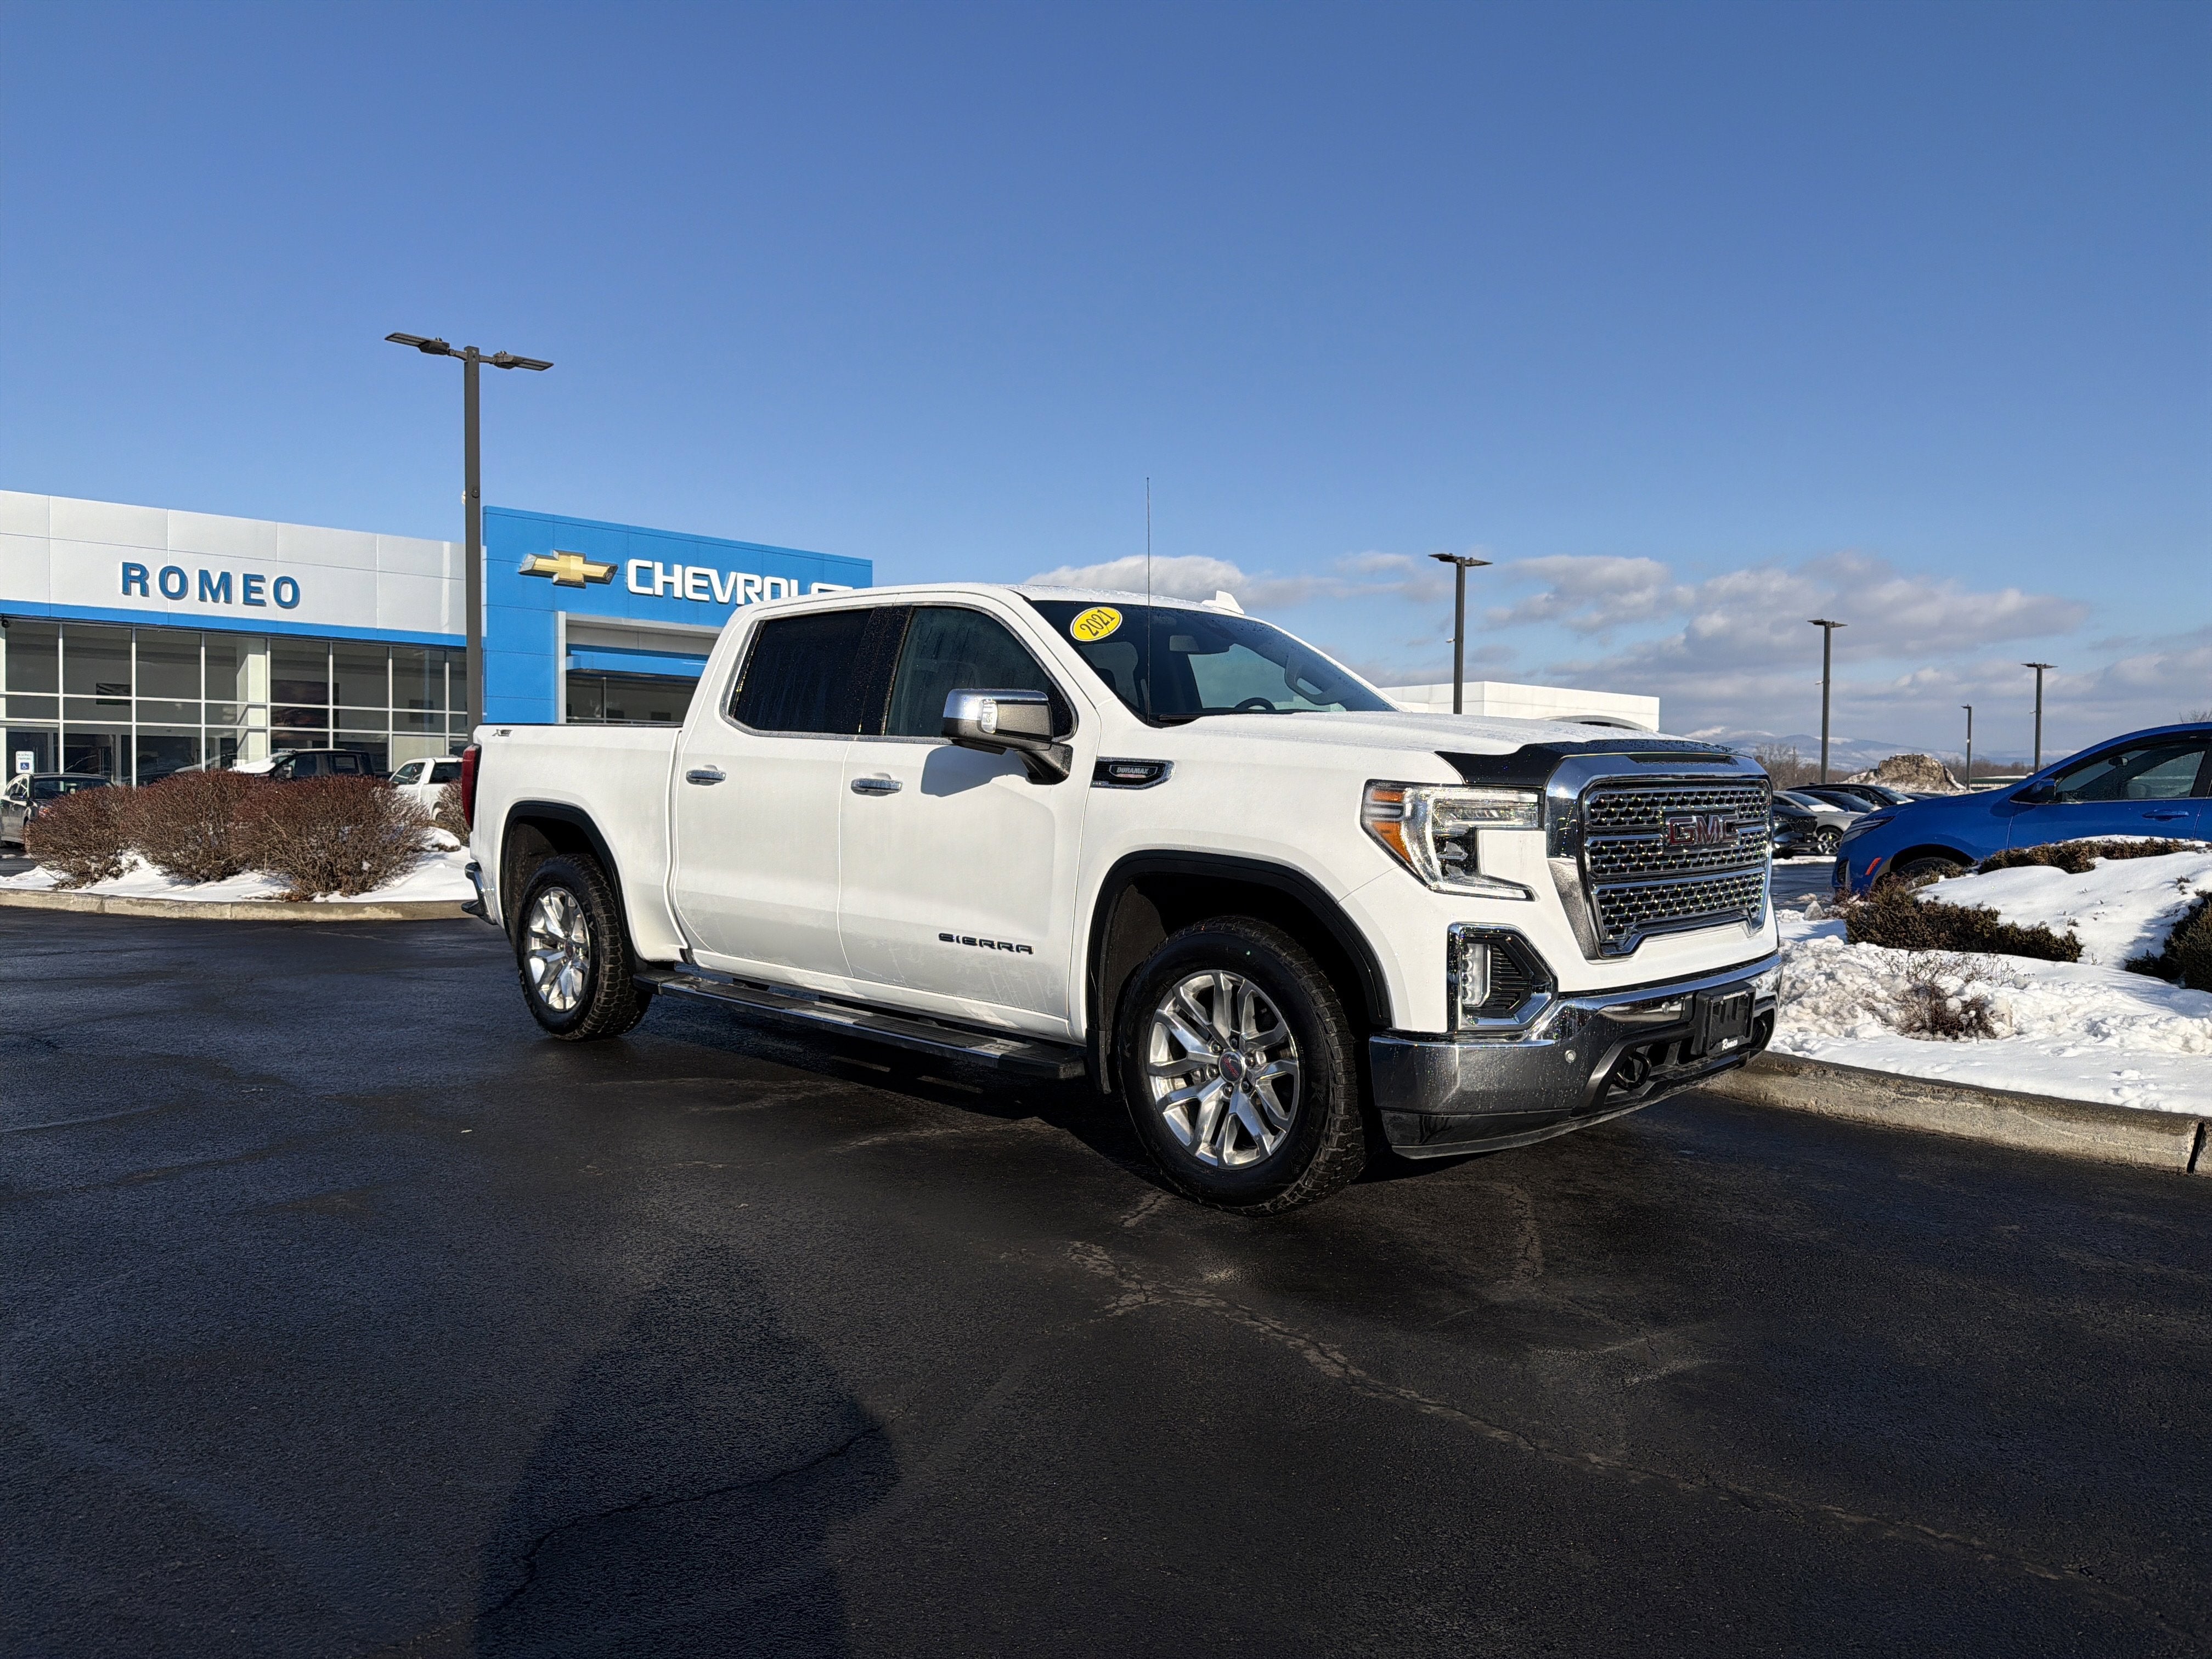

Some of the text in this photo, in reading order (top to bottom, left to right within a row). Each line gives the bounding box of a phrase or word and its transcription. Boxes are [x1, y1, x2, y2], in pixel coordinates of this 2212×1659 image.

[122, 562, 300, 609] ROMEO
[1080, 610, 1115, 636] 2021
[1668, 814, 1739, 845] GMC
[939, 933, 1034, 955] SIERRA
